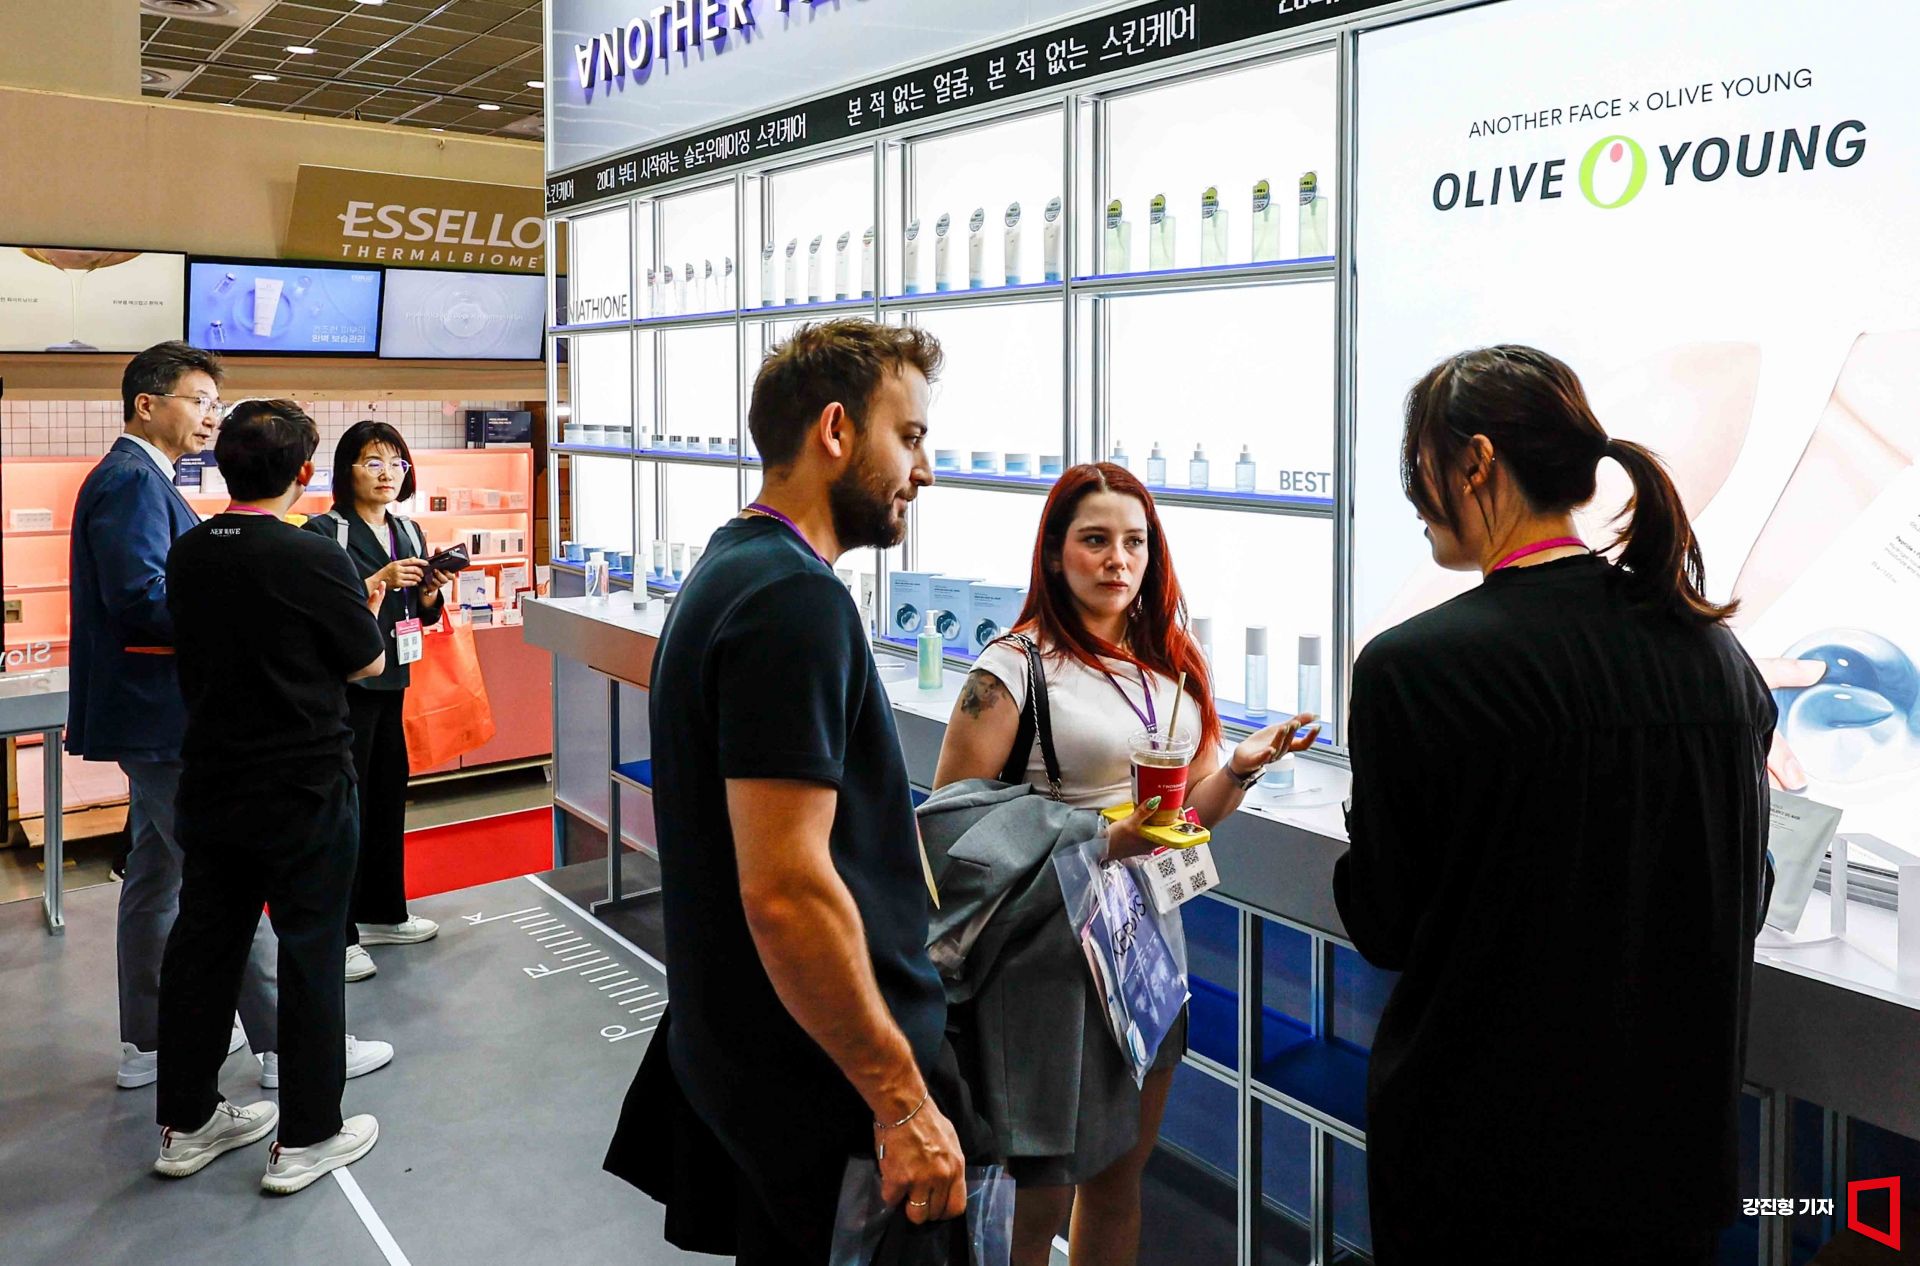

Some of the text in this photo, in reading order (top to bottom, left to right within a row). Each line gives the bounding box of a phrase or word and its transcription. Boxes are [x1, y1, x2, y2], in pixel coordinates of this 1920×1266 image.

[846, 4, 1195, 126] 본 적 없는 얼굴, 본 적 없는 스킨케어
[1469, 108, 1562, 138] ANOTHER
[1569, 99, 1621, 122] FACE
[1646, 83, 1713, 111] OLIVE
[1721, 68, 1813, 98] YOUNG
[597, 167, 615, 191] 20대
[618, 161, 637, 186] 부터
[641, 150, 680, 179] 시작하는
[684, 129, 751, 168] 슬로우에이징
[755, 112, 806, 150] 스킨케어
[1432, 158, 1566, 211] OLIVE
[1659, 119, 1867, 186] YOUNG
[337, 200, 545, 250] ESSELLO
[342, 244, 538, 269] THERMALBIOME
[1280, 471, 1331, 493] BEST
